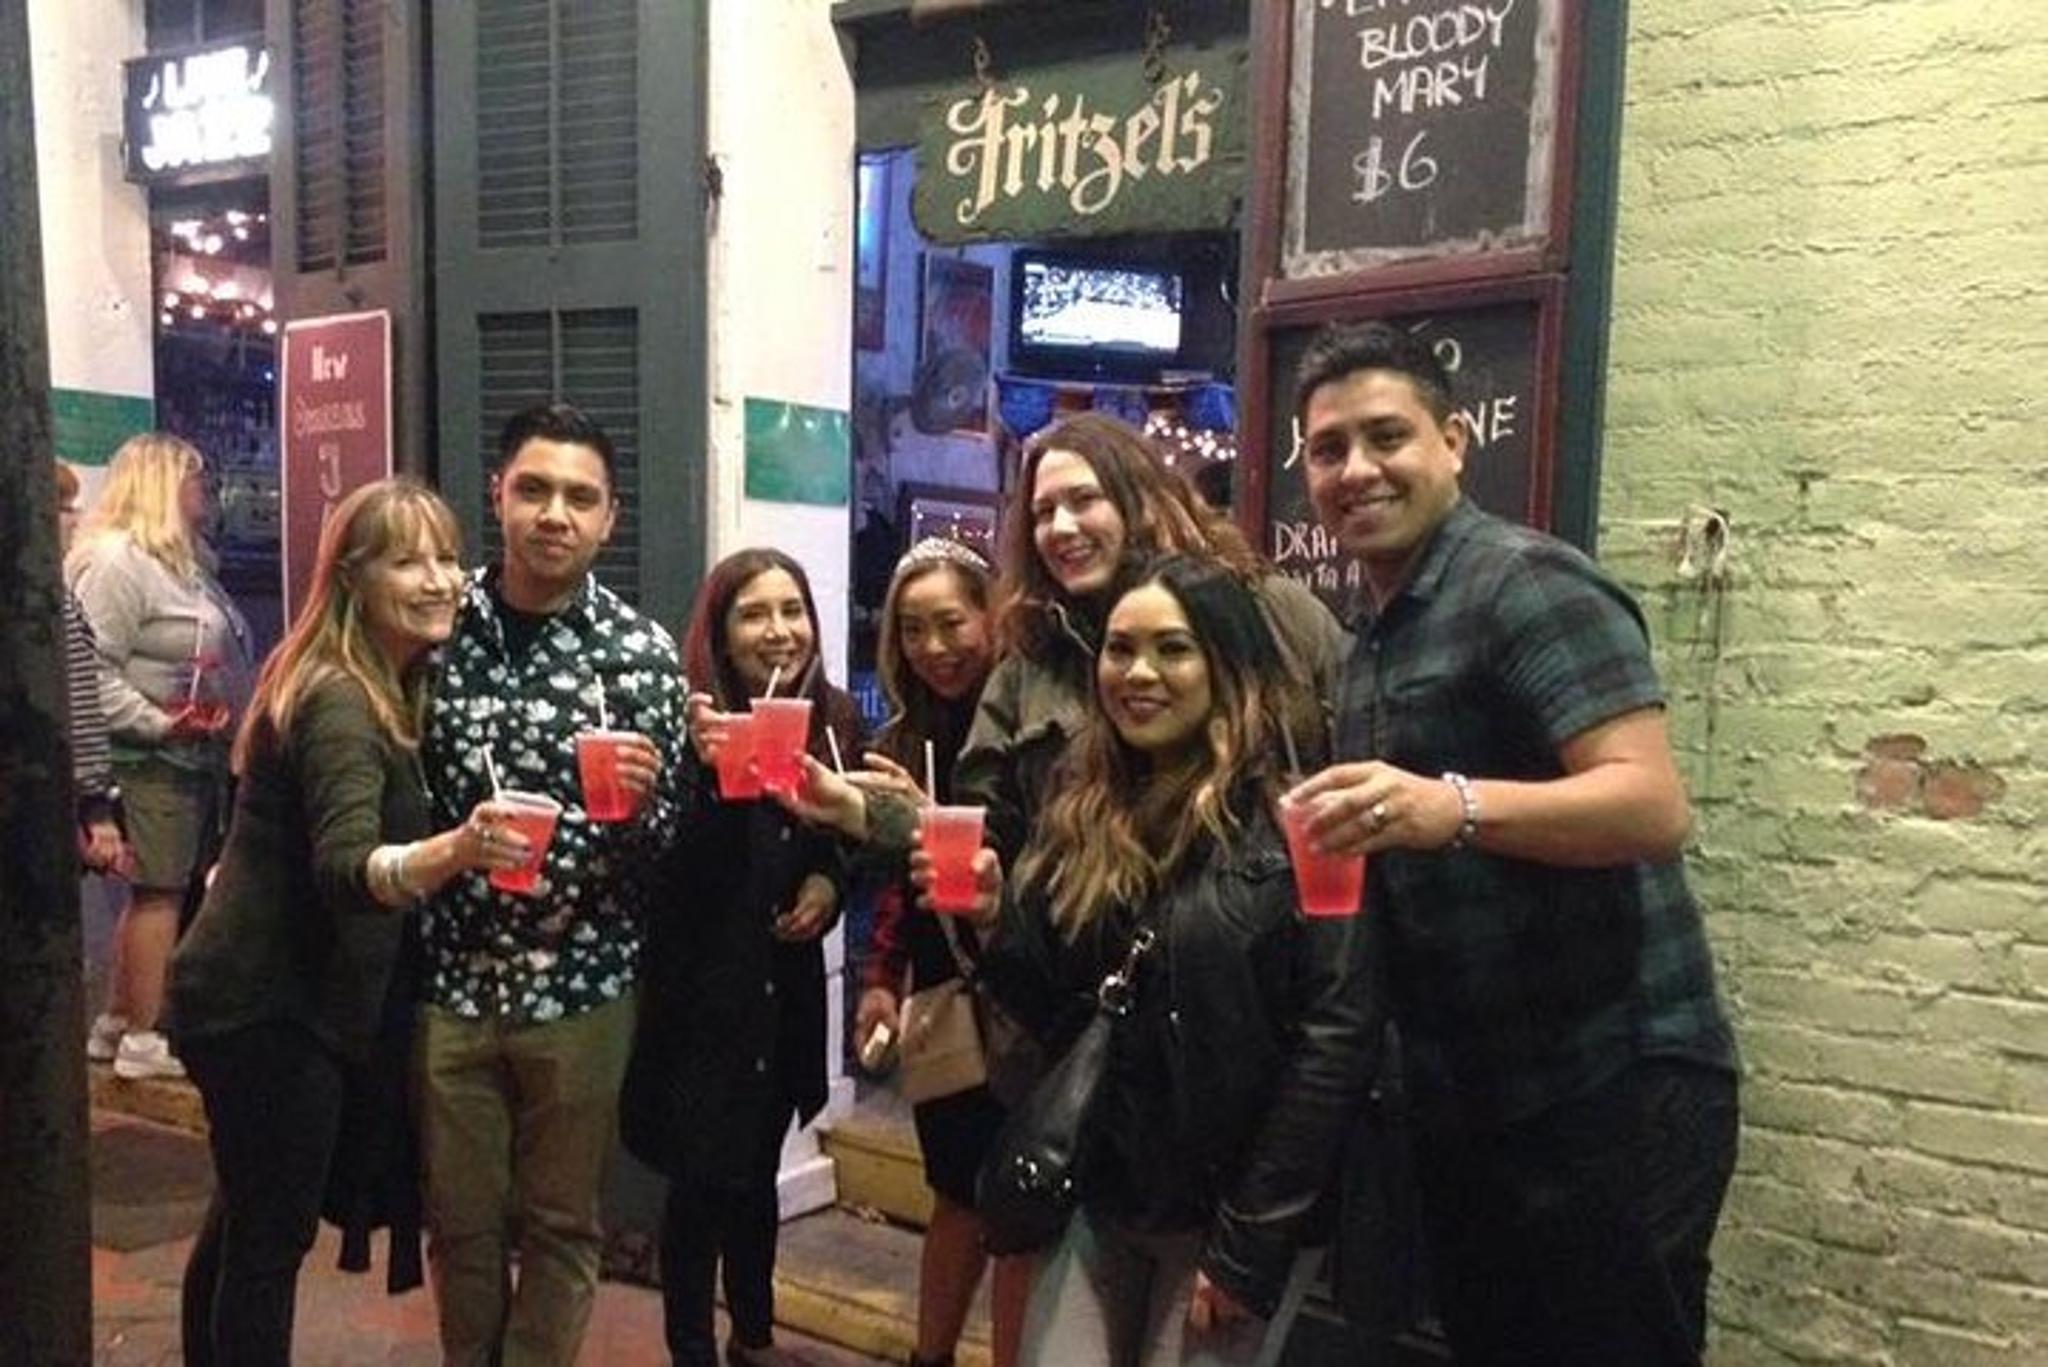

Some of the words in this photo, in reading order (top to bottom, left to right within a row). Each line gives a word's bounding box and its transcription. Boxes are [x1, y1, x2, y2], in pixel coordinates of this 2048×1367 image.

[1357, 0, 1514, 70] BLOODY
[1372, 55, 1490, 119] MARY
[946, 70, 1225, 223] Fritzel's
[1350, 130, 1438, 204] $6
